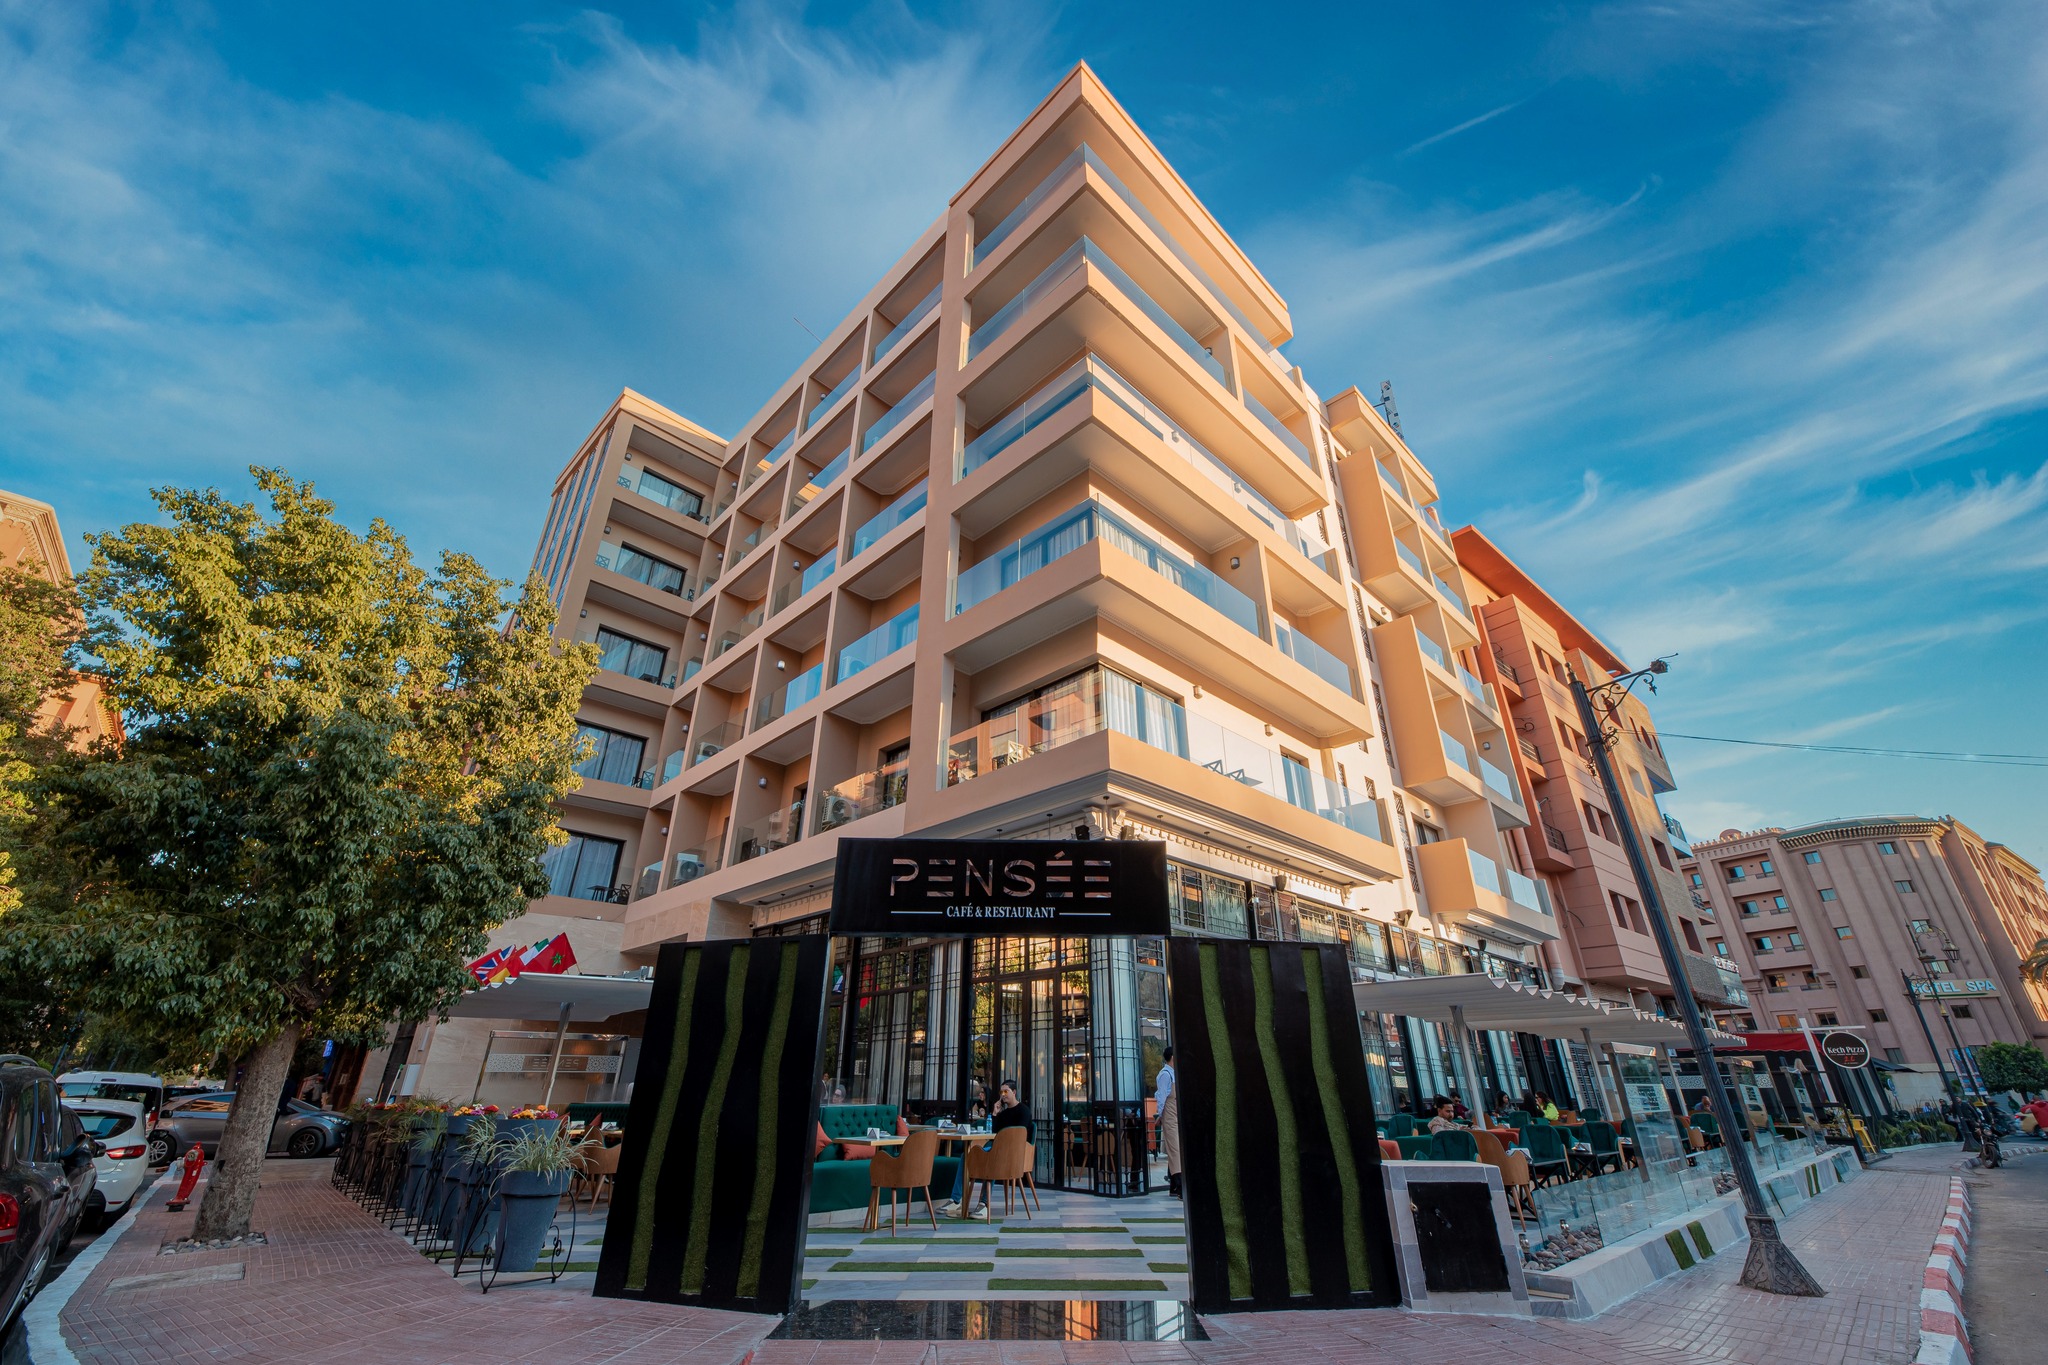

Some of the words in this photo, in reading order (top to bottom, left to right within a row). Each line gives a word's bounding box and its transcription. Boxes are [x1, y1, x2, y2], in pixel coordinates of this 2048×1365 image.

[889, 850, 1112, 899] PENSÉE
[946, 902, 974, 918] CAFÉ
[975, 906, 983, 918] &
[984, 906, 1056, 919] RESTAURANT
[1911, 981, 1962, 994] HOTEL
[1965, 979, 1997, 992] SPA
